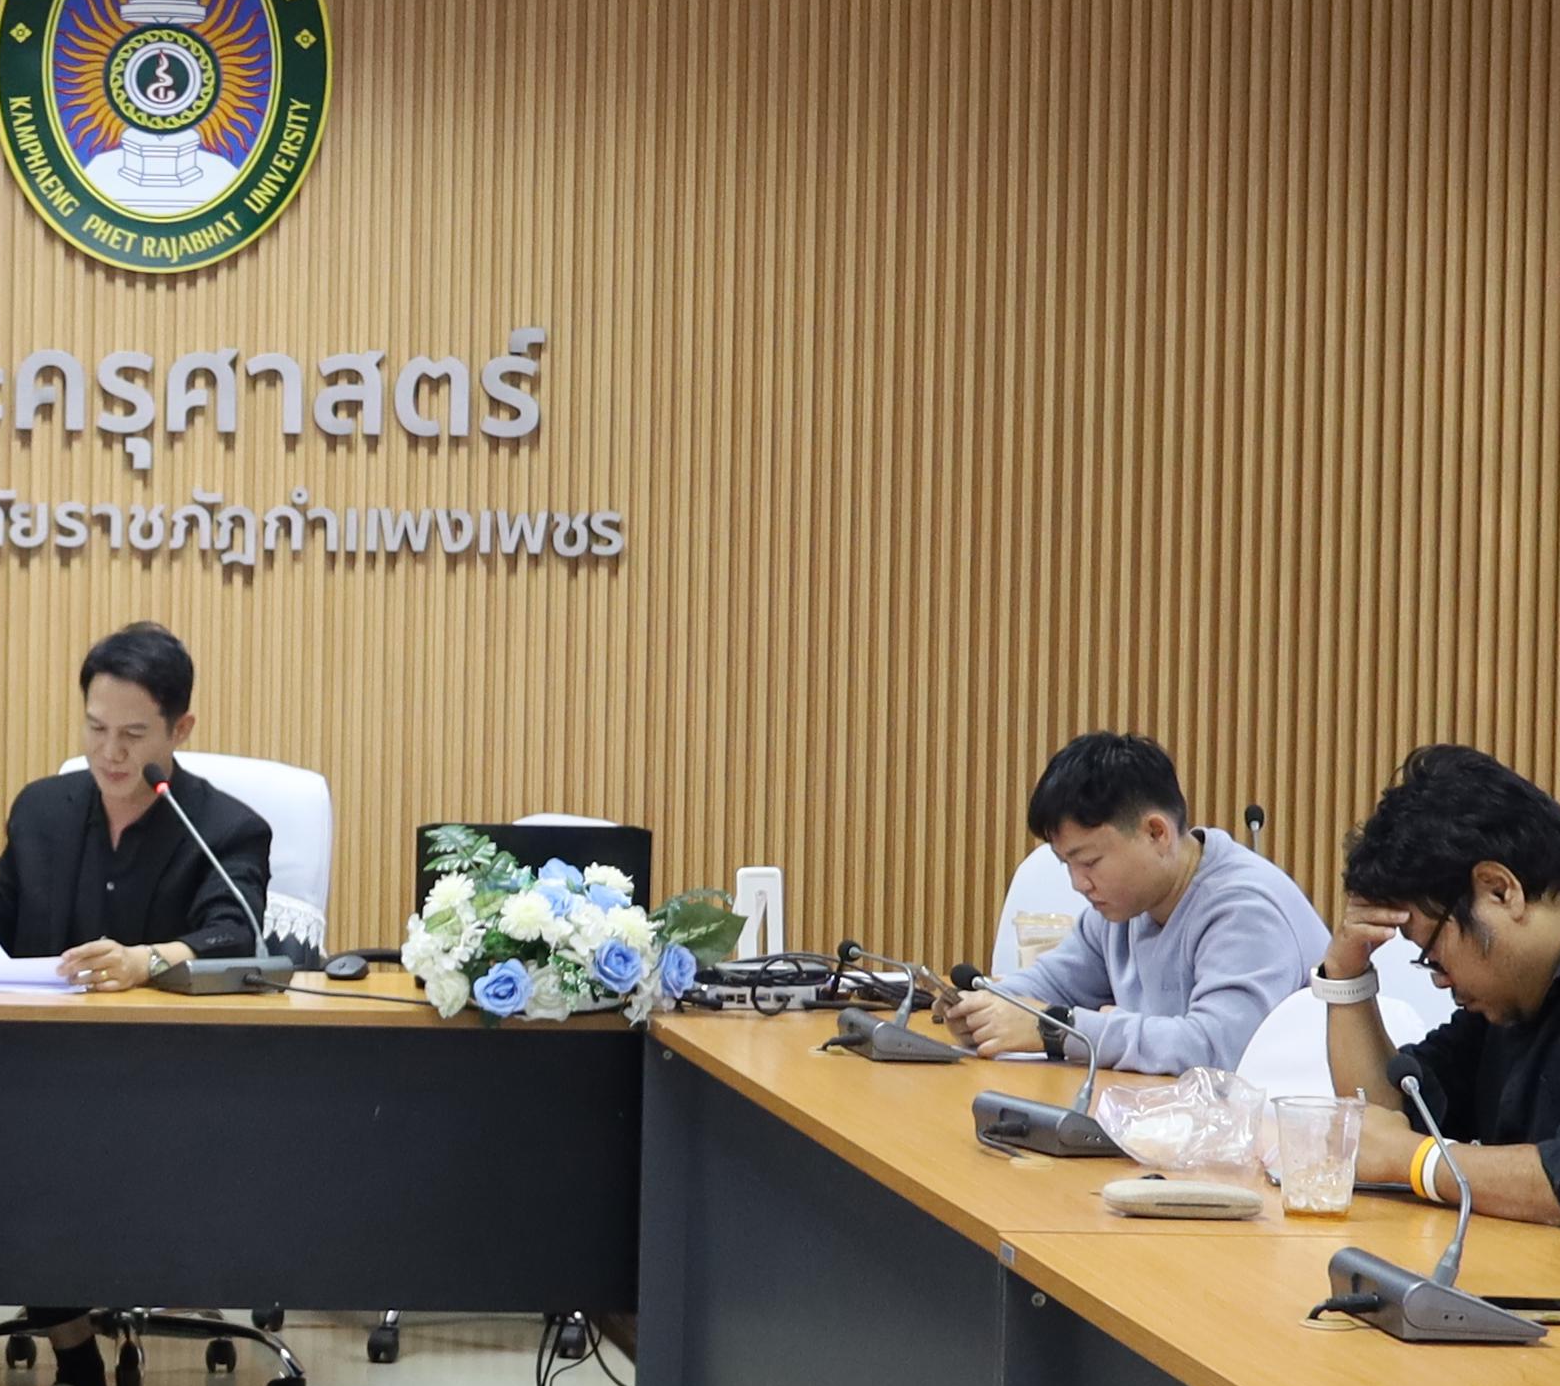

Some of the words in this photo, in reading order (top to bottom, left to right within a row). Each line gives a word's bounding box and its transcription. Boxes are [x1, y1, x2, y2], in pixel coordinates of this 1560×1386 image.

[8, 96, 81, 218] KAMPHAENG
[81, 213, 139, 253] PHET
[141, 211, 243, 264] RAJABHAT
[243, 98, 311, 215] UNIVERSITY
